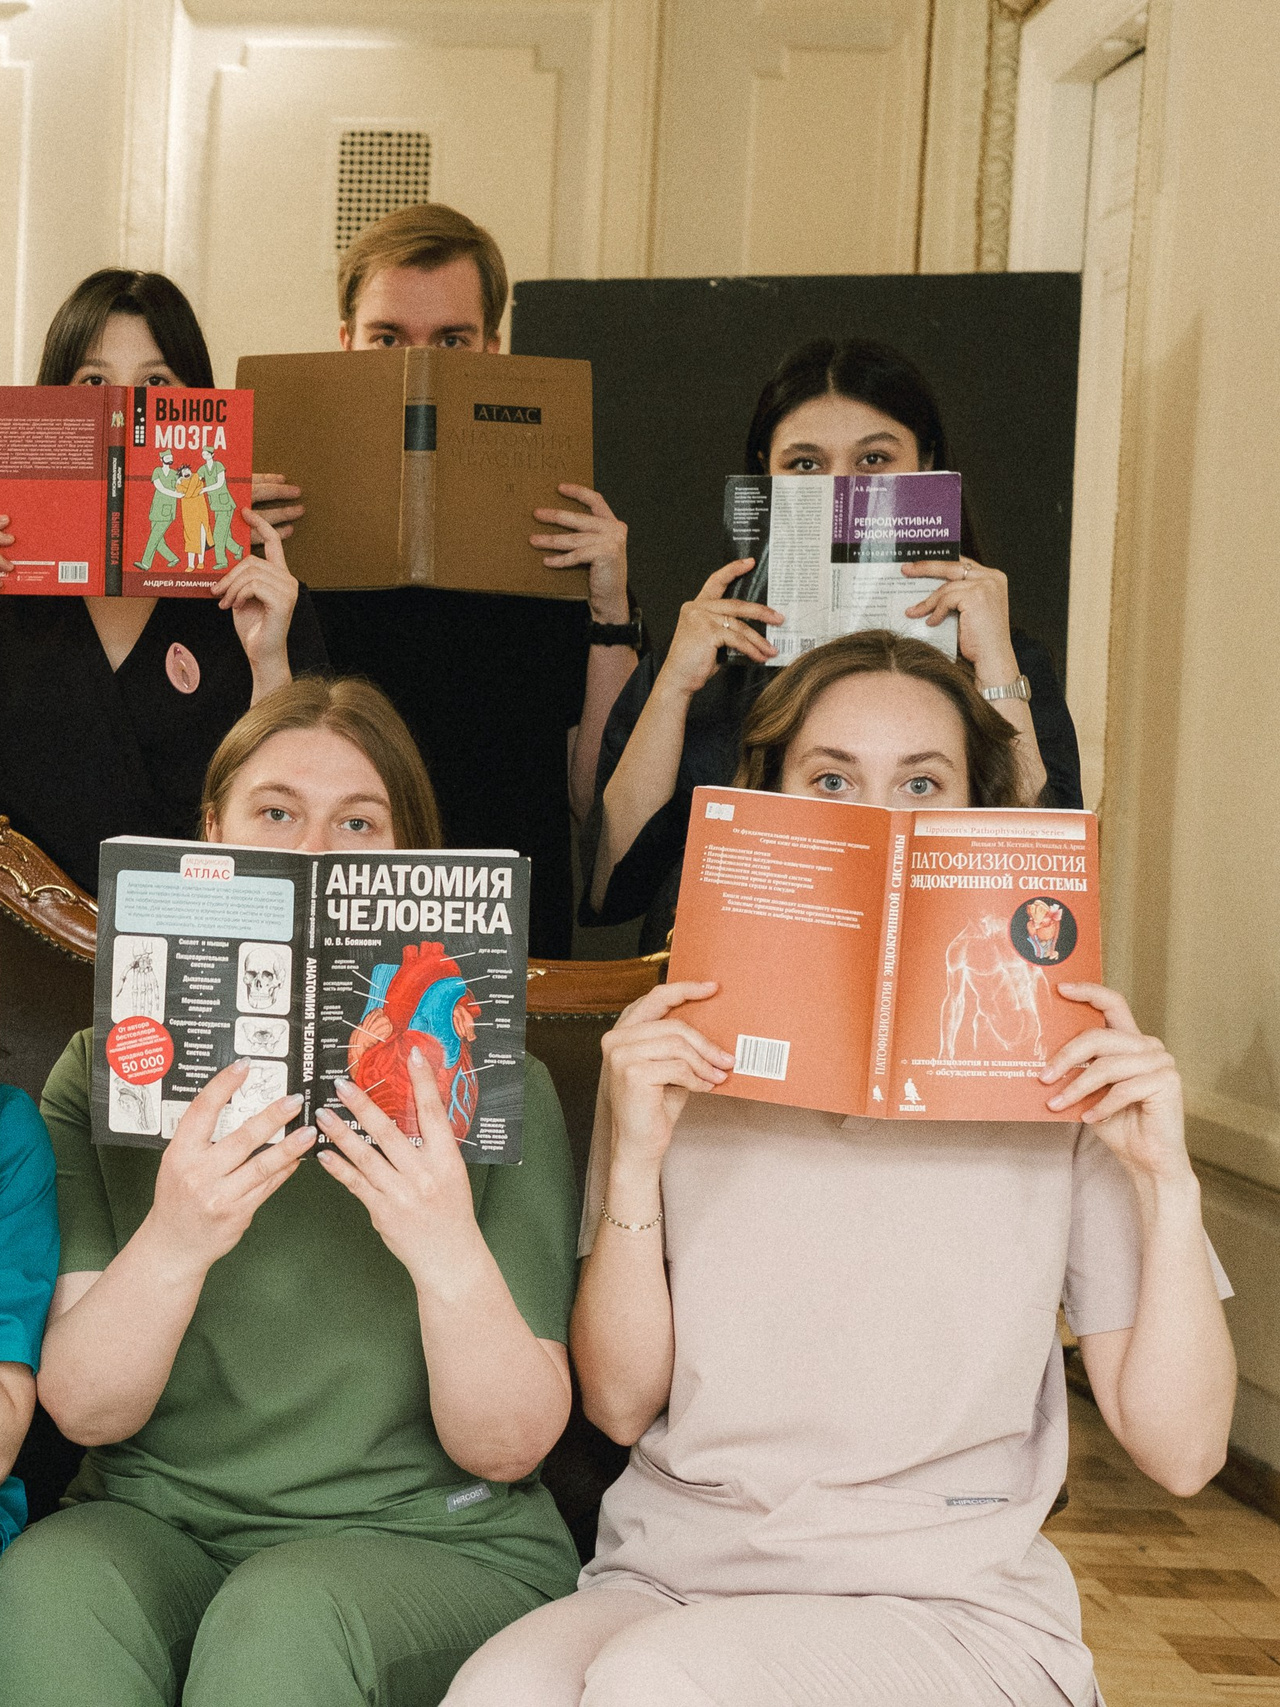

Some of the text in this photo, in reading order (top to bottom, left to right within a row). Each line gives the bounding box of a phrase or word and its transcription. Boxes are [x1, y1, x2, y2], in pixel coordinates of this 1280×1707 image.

[155, 397, 228, 423] ВЫНОС
[477, 405, 538, 423] АТЛАС
[154, 425, 227, 450] МОЗГА
[854, 516, 942, 527] РЕПРОДУКТИВНАЯ
[110, 511, 120, 565] ВЫНОС МОЗГА
[854, 528, 950, 539] ЭНДОКРИНОЛОГИЯ
[143, 579, 173, 587] АНДРЕЙ
[925, 825, 1065, 837] Lippincott's Pathophysiology Series
[911, 852, 1086, 873] ПАТОФИЗИОЛОГИЯ
[184, 868, 230, 880] АТЛАС
[324, 863, 512, 899] АНАТОМИЯ
[910, 873, 1088, 892] ЭНДОКРИННОЙ СИСТЕМЫ
[326, 898, 512, 935] ЧЕЛОВЕКА
[324, 937, 382, 947] Ю. В. Боянович
[875, 834, 906, 1076] ПАТОФИЗИОЛОГИЯ ЭНДОКРИННОЙ СИСТЕМЫ
[127, 1021, 150, 1032] автора
[303, 957, 318, 1083] АНАТОМИЯ ЧЕЛОВЕКА
[121, 1054, 165, 1074] 50 000
[912, 1058, 981, 1068] патофизиология
[992, 1059, 1046, 1067] клиническая
[935, 1069, 987, 1077] обсуждение
[989, 1070, 1025, 1079] историй
